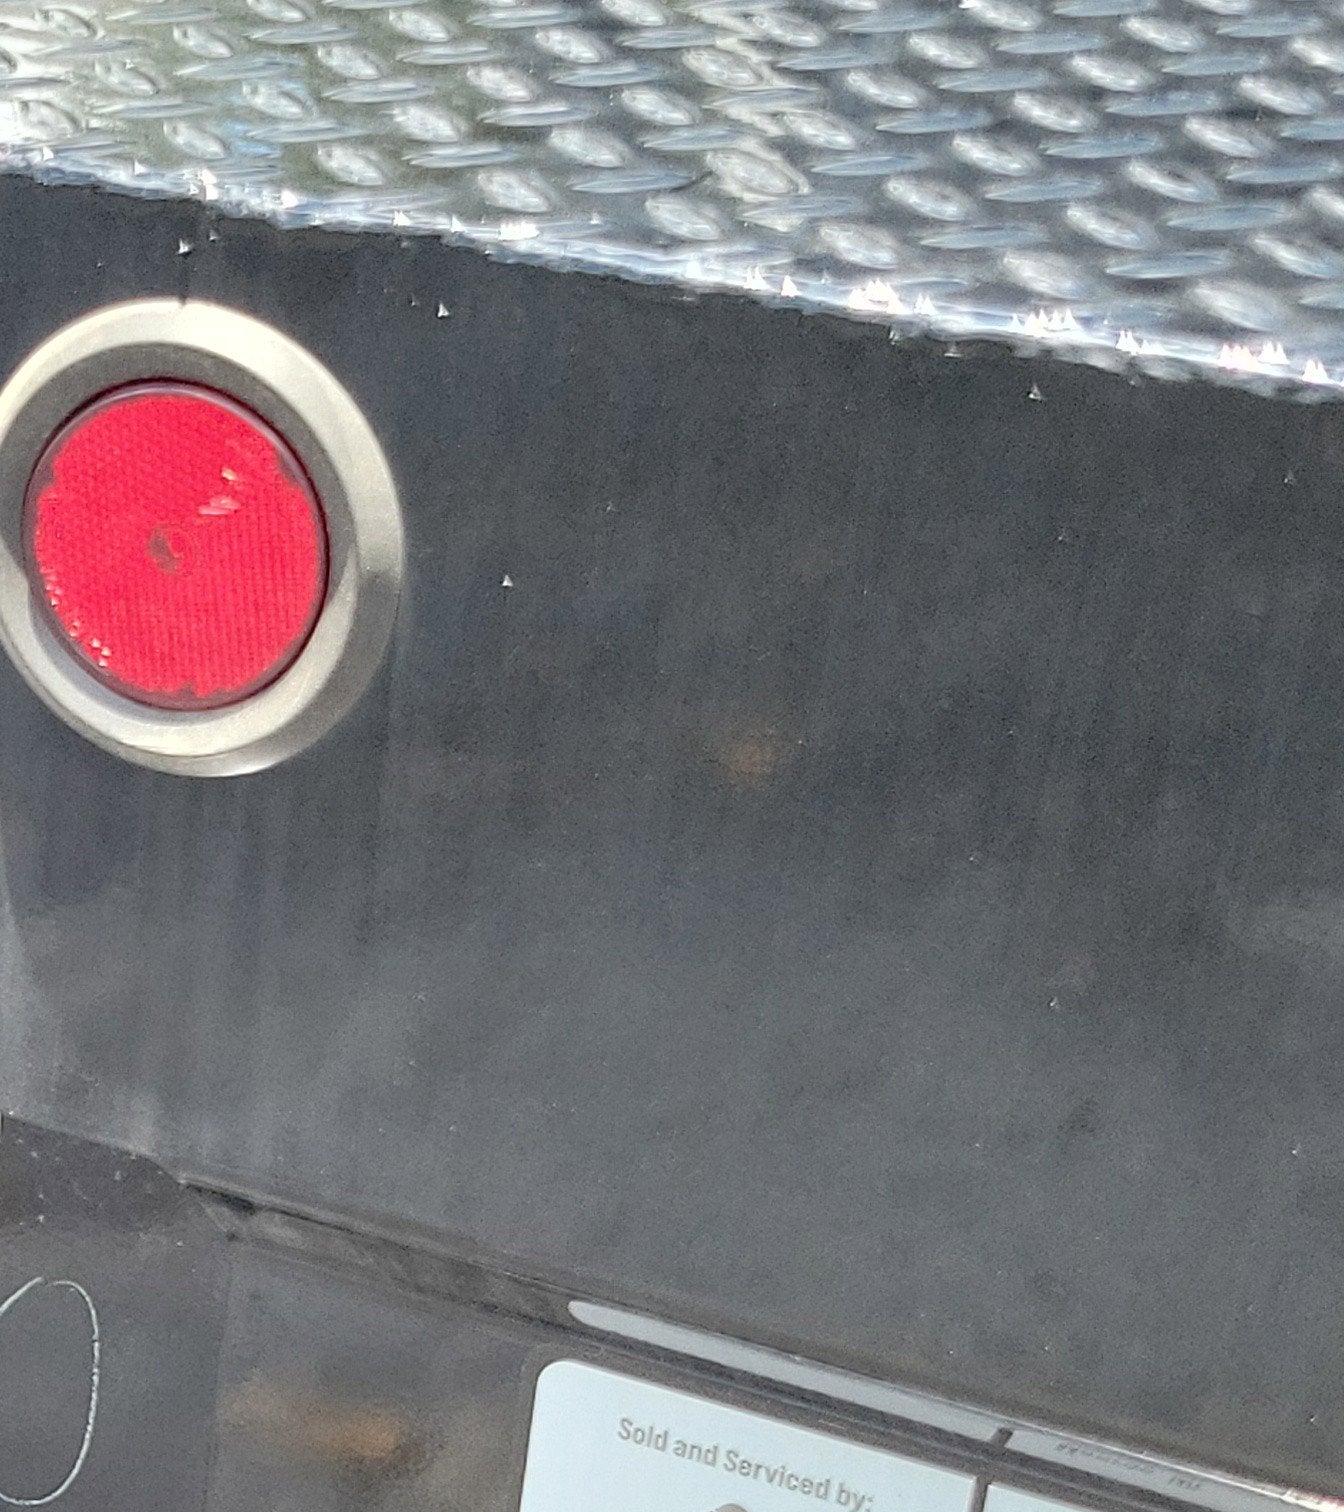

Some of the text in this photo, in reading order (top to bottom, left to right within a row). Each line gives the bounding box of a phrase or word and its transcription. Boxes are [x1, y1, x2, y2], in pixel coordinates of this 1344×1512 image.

[617, 1417, 669, 1452] Sold
[671, 1433, 720, 1468] and
[722, 1449, 832, 1502] Serviced
